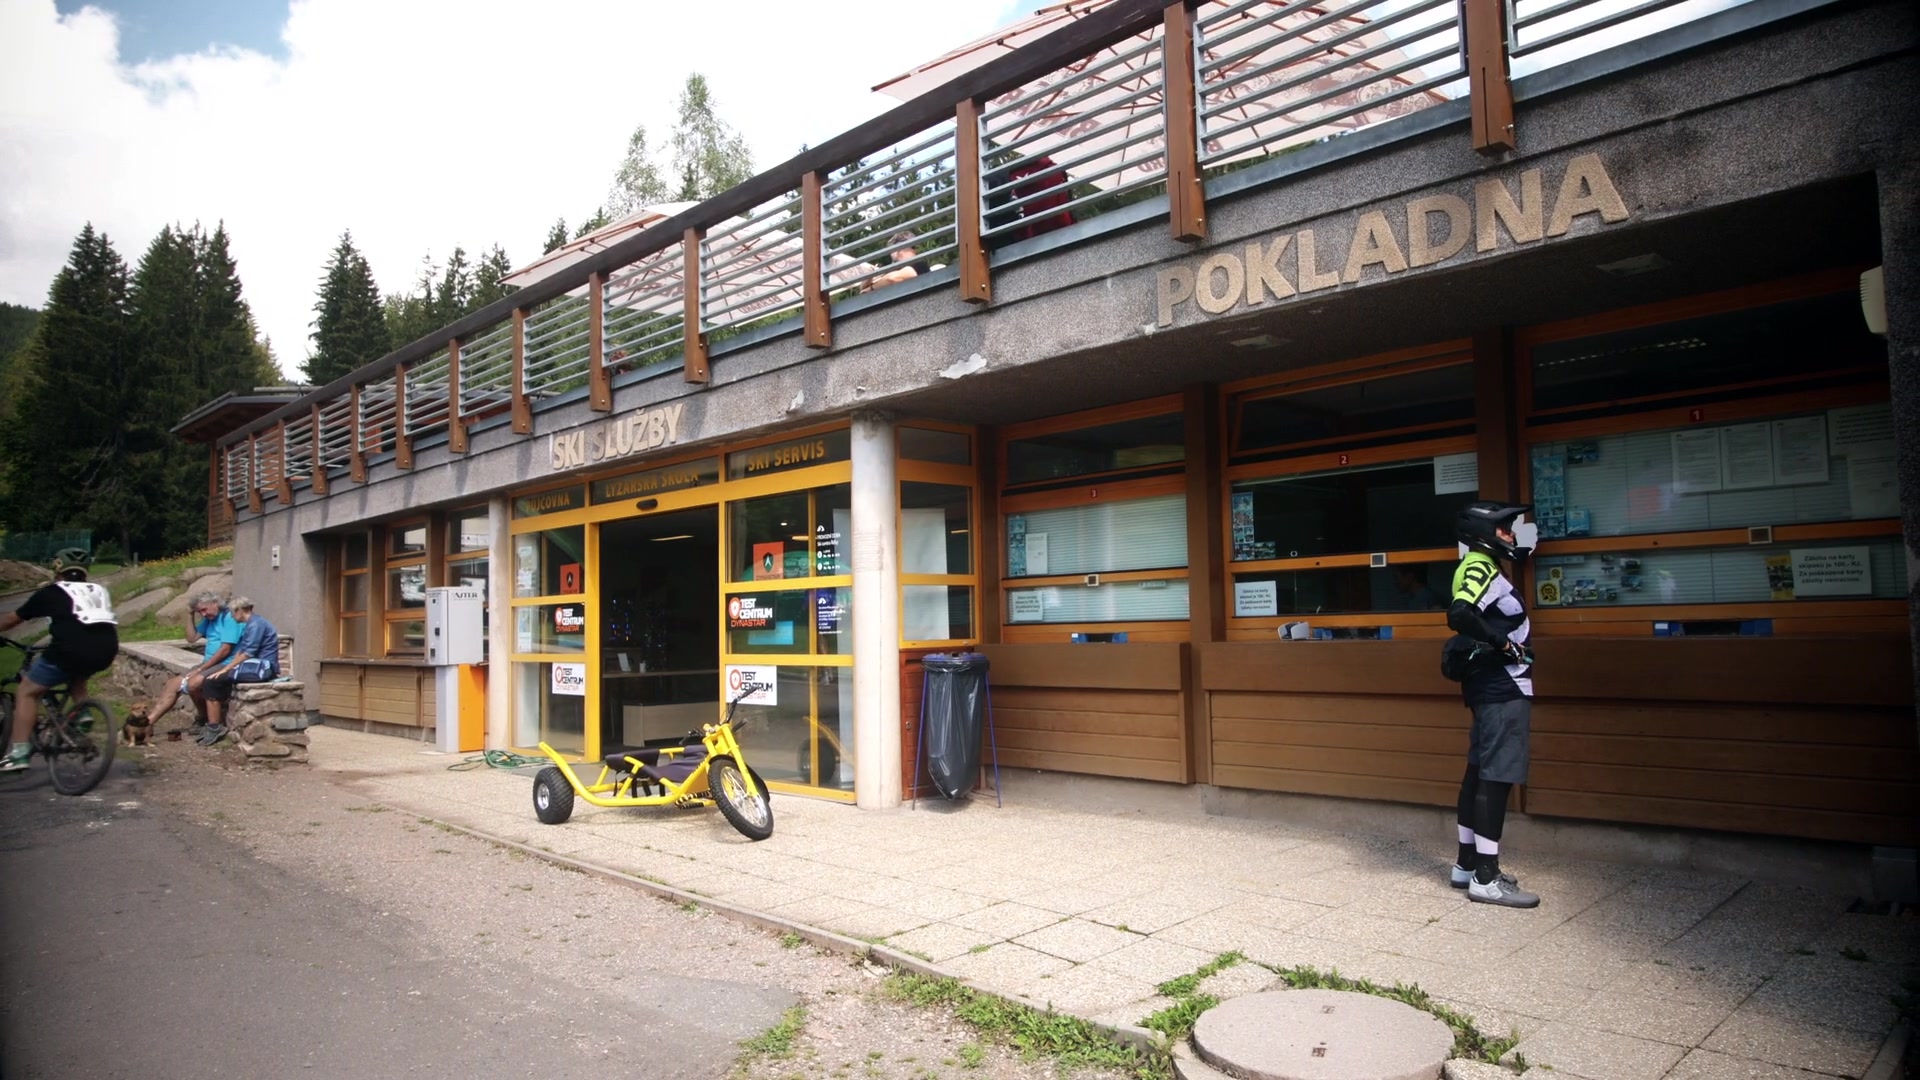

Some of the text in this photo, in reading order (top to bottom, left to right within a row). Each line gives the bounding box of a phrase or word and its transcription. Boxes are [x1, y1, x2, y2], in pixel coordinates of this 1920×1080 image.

[1157, 153, 1630, 328] POKLADNA
[1693, 410, 1700, 420] 1
[553, 403, 684, 470] SKI SLUŽBY
[747, 440, 825, 471] SKI SERVIS
[1341, 455, 1347, 464] 2
[740, 598, 756, 608] TEST
[562, 608, 574, 617] TEST
[739, 608, 773, 619] CENTRUM
[562, 616, 584, 626] CENTRUM
[731, 619, 766, 627] DYNASTAR
[562, 668, 573, 676] TEST
[741, 671, 756, 681] TEST
[562, 676, 584, 686] CENTRUM
[740, 681, 773, 693] CENTRUM
